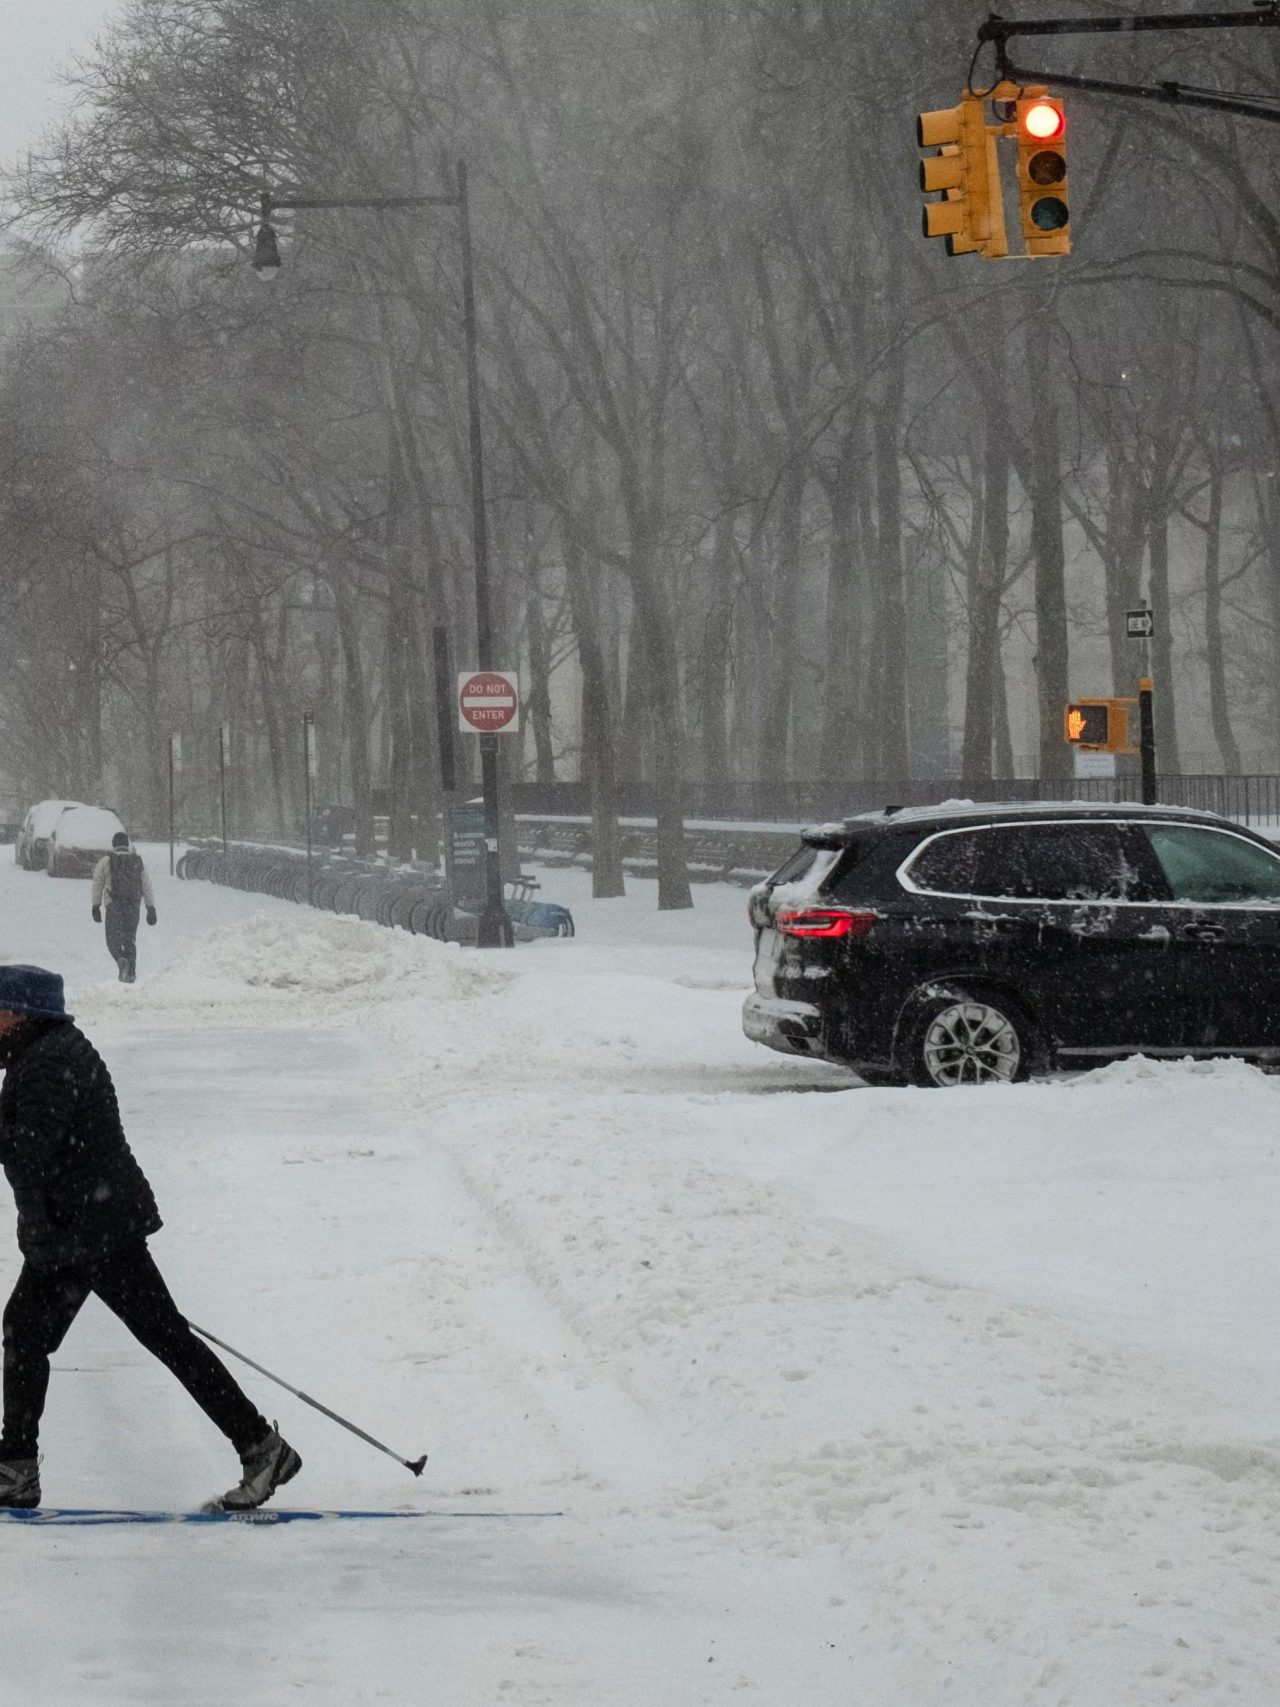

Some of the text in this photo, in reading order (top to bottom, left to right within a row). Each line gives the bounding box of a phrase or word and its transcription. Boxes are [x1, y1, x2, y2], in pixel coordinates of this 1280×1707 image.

[469, 684, 506, 694] DO NOT
[472, 710, 505, 720] ENTER
